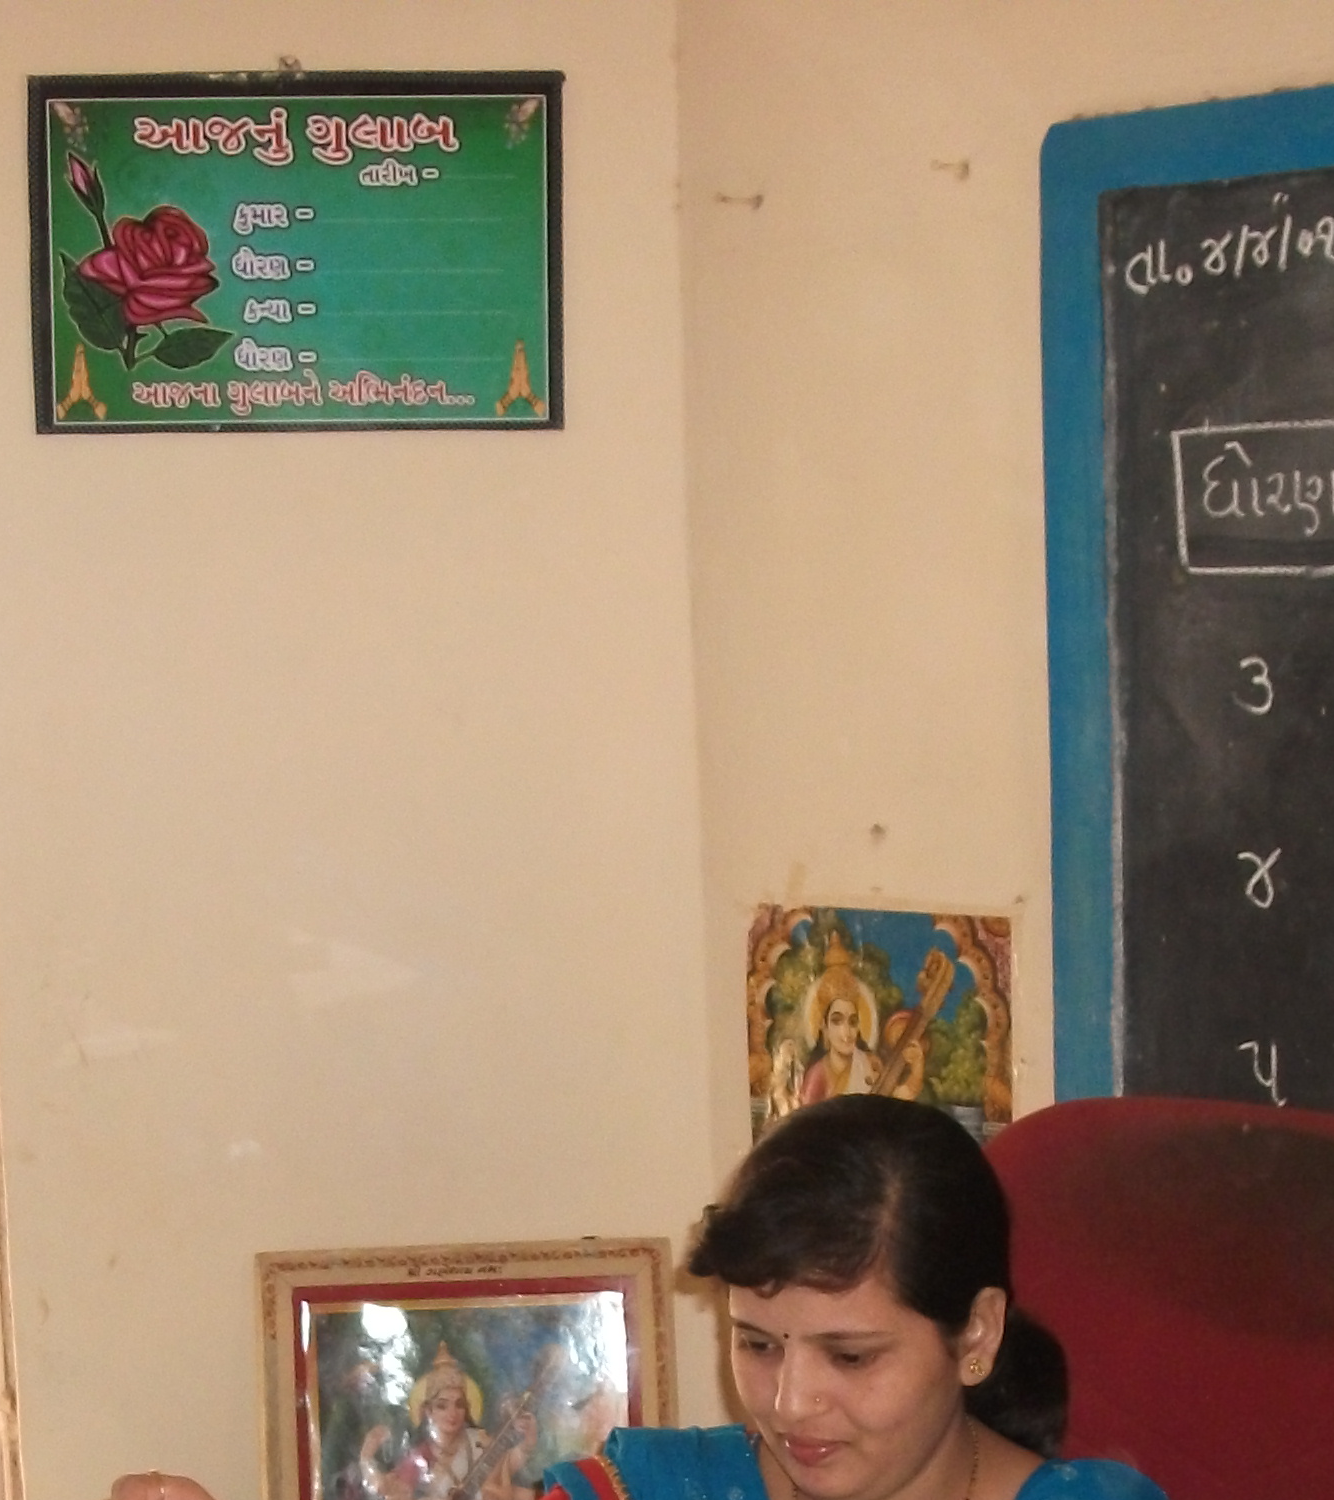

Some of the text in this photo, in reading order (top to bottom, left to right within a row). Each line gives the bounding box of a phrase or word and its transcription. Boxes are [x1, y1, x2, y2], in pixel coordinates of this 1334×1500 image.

[134, 107, 460, 166] આજનું ગુલાબ
[359, 157, 418, 186] તારીખ
[233, 203, 289, 235] કુમાર
[243, 298, 292, 323] કન્યા
[132, 381, 221, 408] આજના
[227, 369, 323, 416] ગુલાબને
